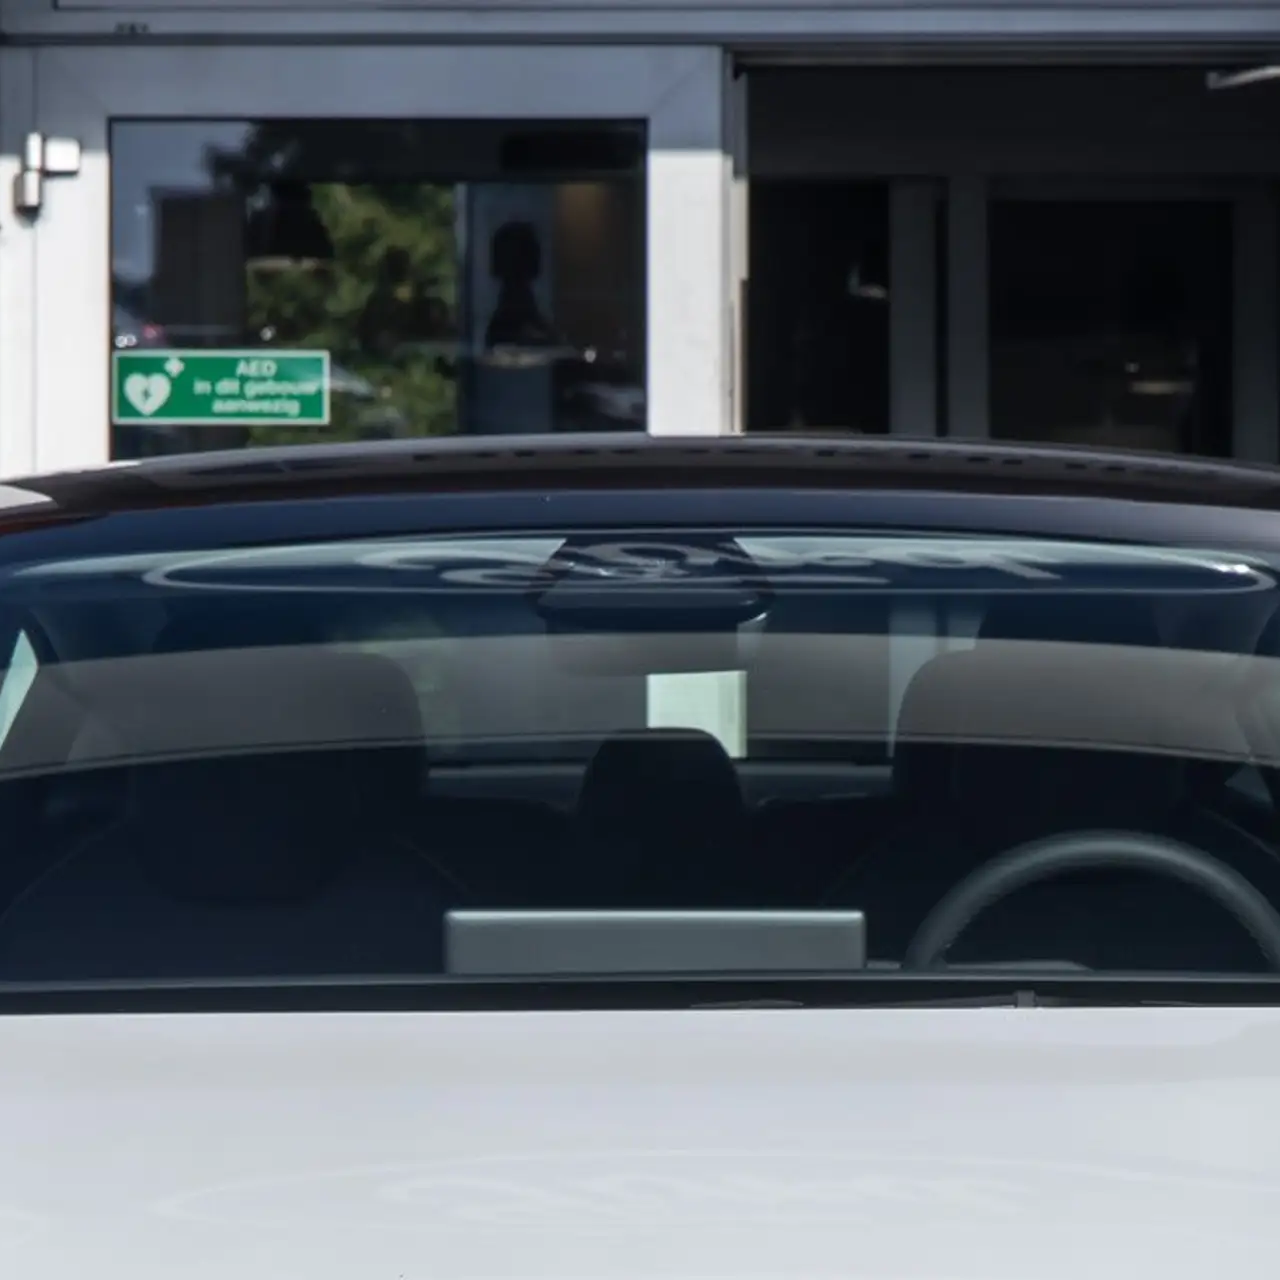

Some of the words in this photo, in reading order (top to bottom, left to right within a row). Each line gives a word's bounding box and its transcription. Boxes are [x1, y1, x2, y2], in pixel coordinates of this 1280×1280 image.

[236, 359, 277, 377] AED
[215, 377, 240, 395] dit
[243, 378, 319, 400] gebouw
[212, 398, 301, 417] aanwezig
